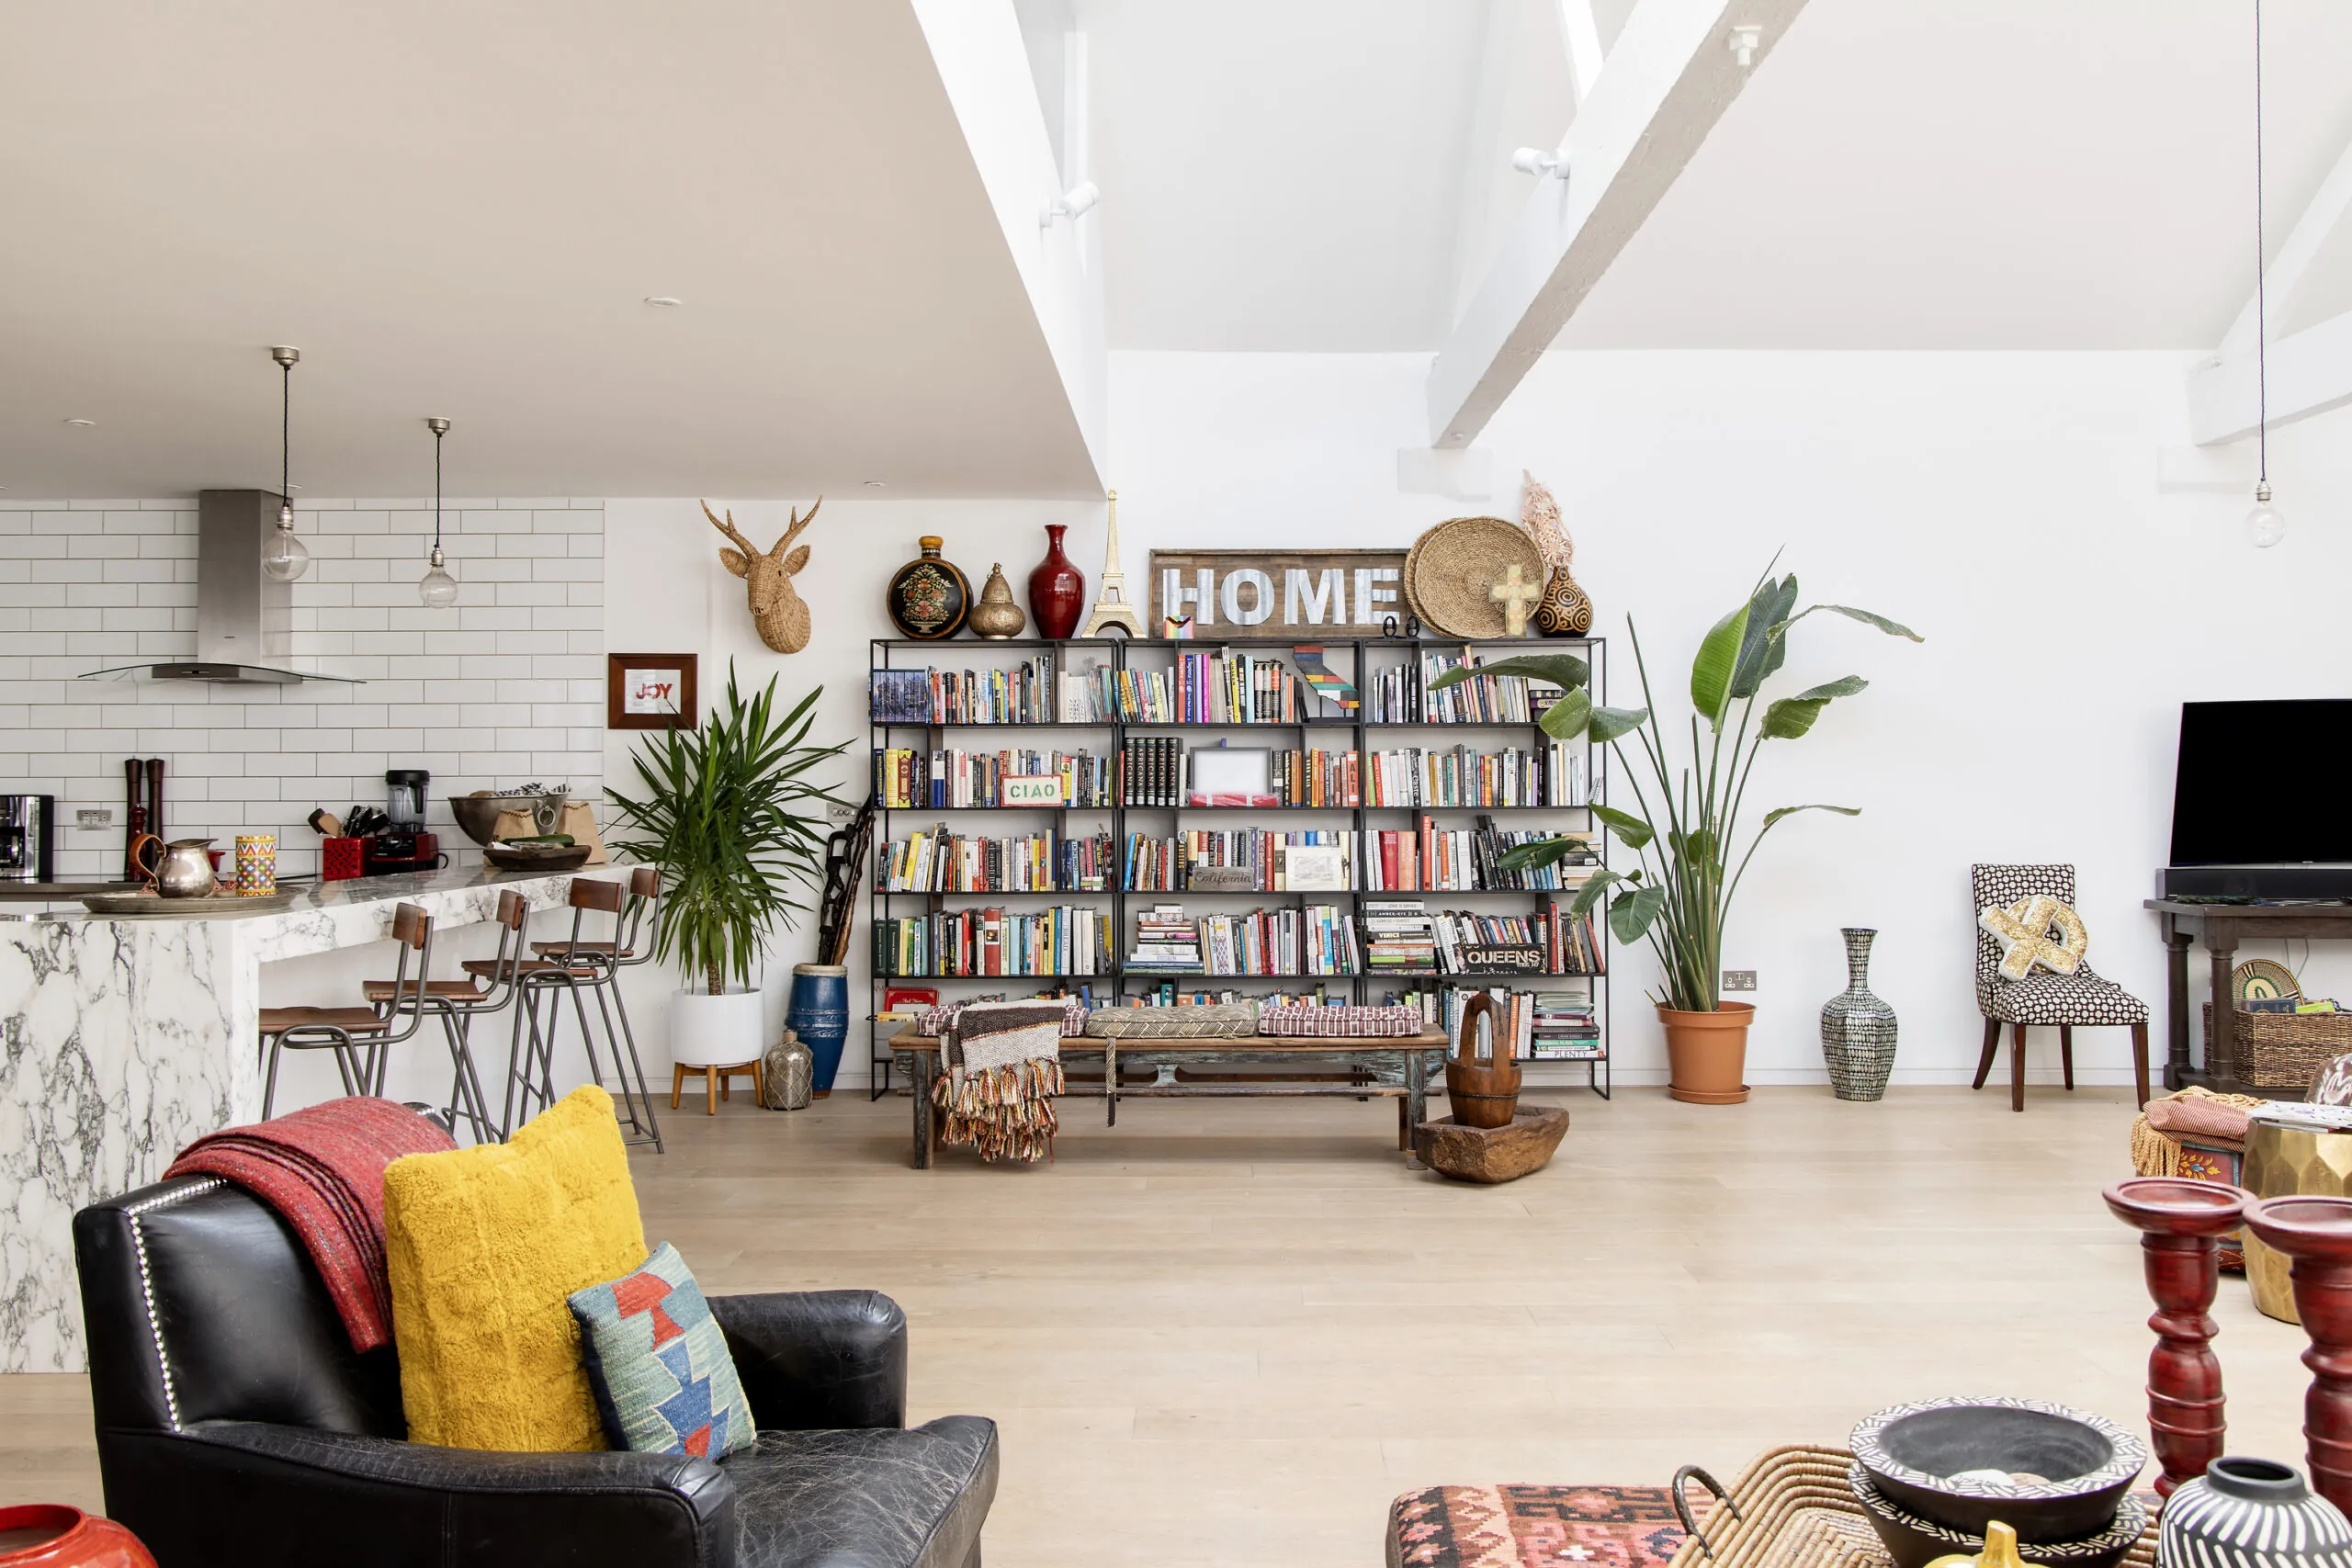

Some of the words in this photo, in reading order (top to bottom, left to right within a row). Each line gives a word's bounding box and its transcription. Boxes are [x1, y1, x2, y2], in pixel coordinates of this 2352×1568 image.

[1162, 569, 1400, 625] HOME
[636, 683, 673, 699] JOY
[1010, 784, 1055, 798] CIAO
[1193, 871, 1252, 886] California
[1467, 950, 1541, 964] QUEENS
